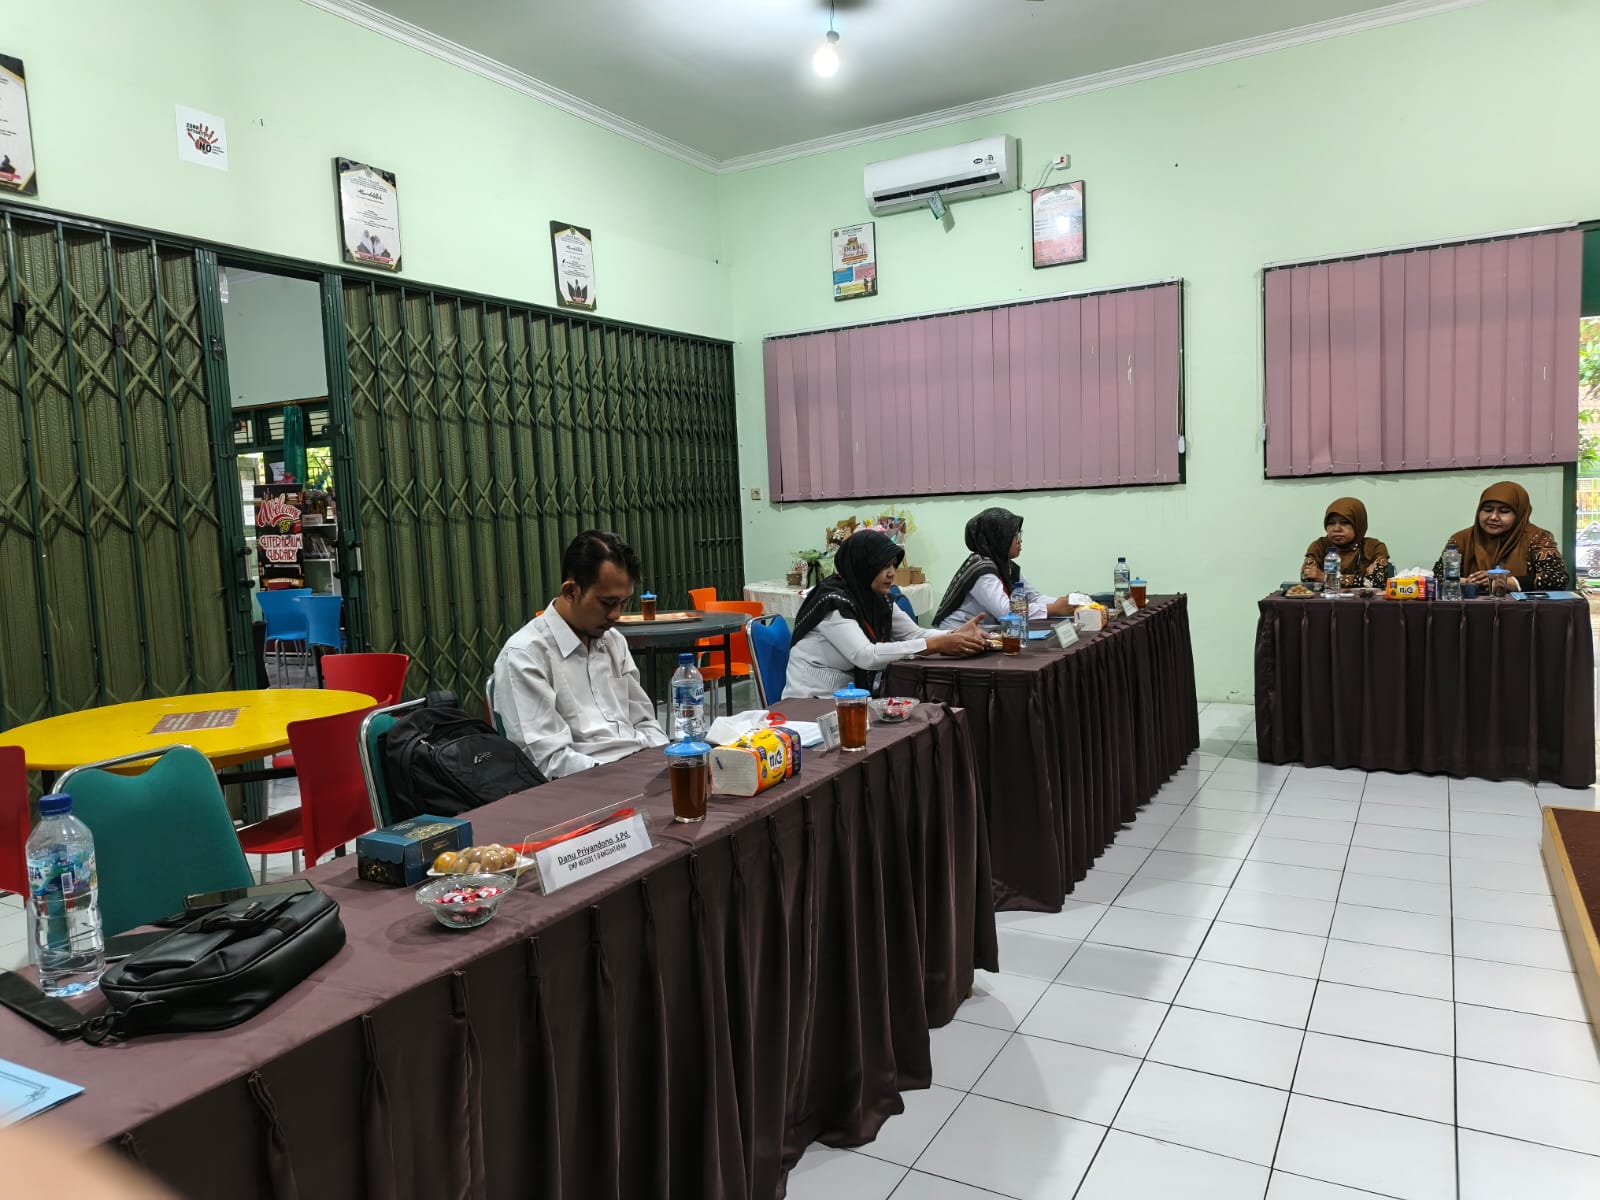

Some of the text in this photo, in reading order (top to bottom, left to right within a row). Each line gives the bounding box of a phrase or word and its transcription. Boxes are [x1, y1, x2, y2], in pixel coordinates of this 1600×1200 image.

[199, 141, 212, 153] NO
[258, 493, 301, 527] Welcome
[557, 852, 576, 865] Danu
